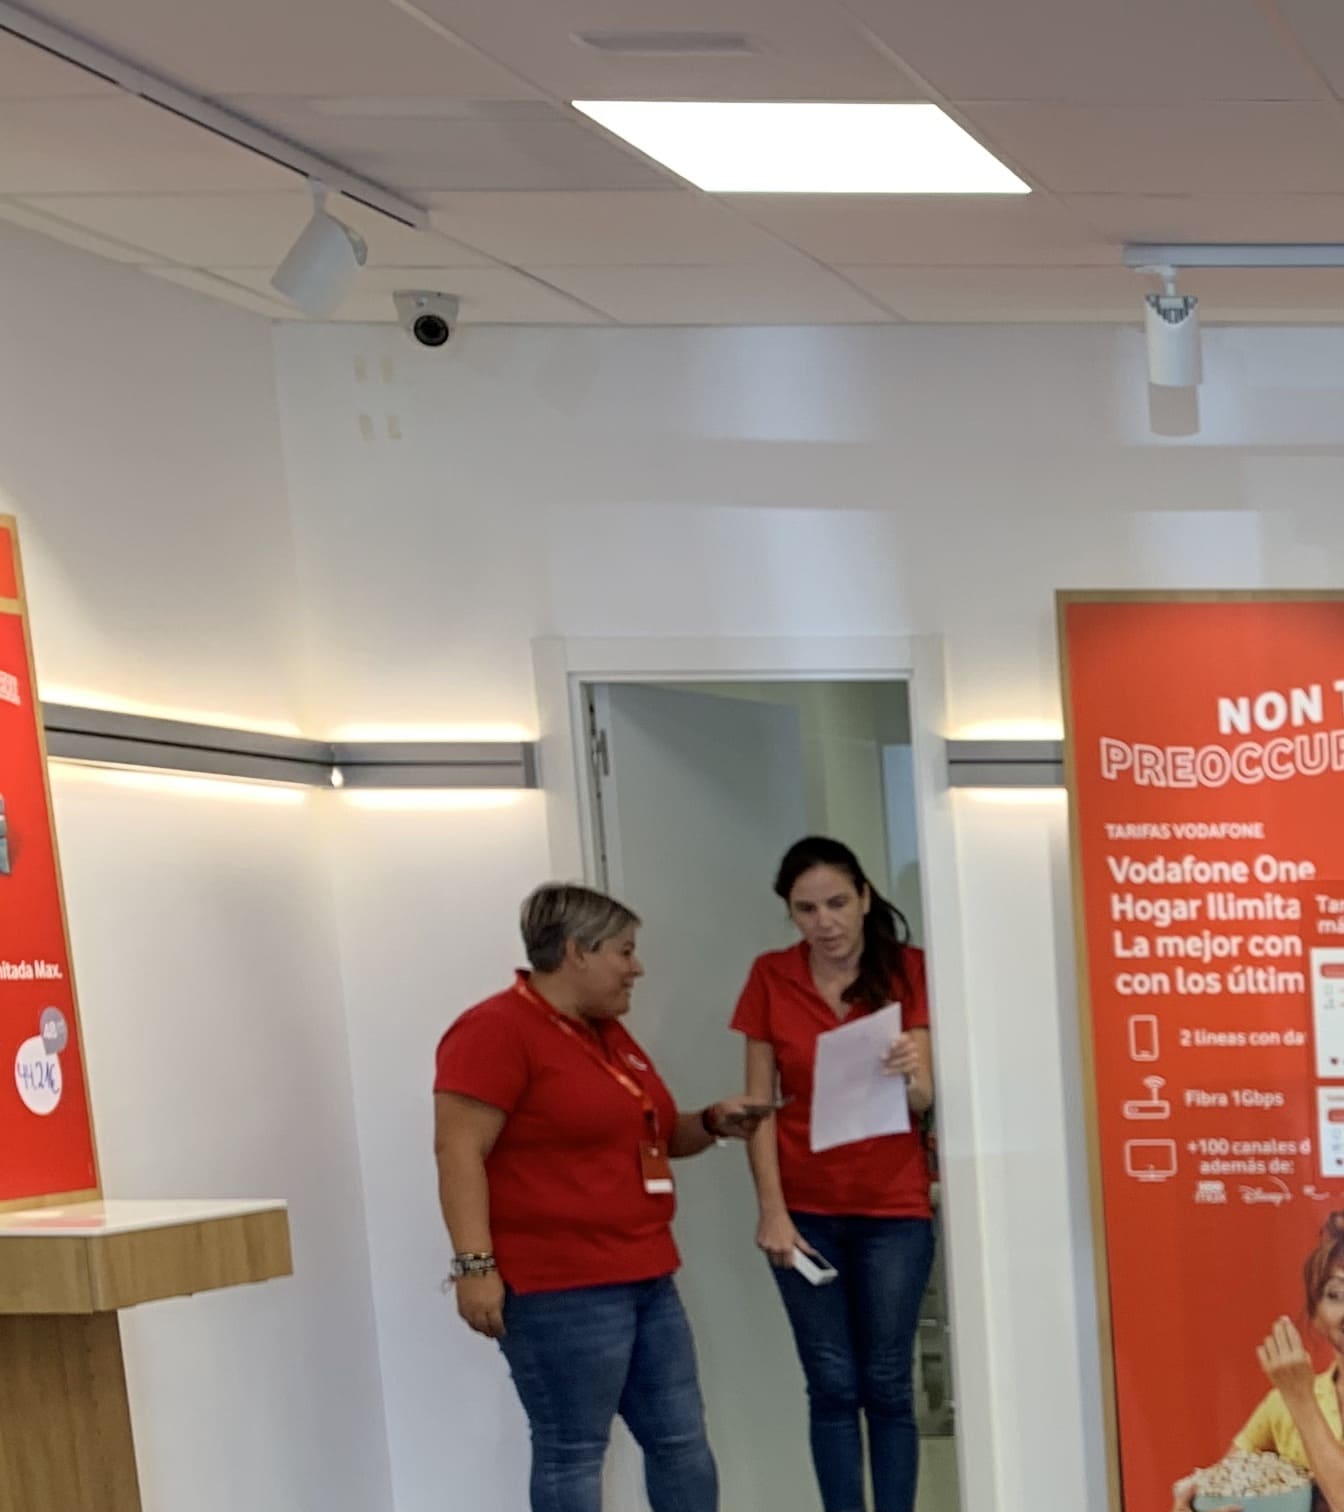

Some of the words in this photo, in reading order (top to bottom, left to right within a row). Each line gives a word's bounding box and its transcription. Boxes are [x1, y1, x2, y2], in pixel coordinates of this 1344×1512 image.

[1218, 684, 1323, 734] NON
[1104, 823, 1170, 840] TARIFAS
[1173, 822, 1264, 839] VODAFONE
[1107, 855, 1249, 884] Vodafone
[1254, 854, 1315, 883] One
[1110, 893, 1201, 927] Hogar
[1206, 892, 1301, 920] Ilimita
[1113, 930, 1149, 958] La
[1156, 930, 1243, 963] mejor
[1248, 935, 1302, 957] con
[0, 959, 33, 980] itada
[34, 959, 63, 979] Max.
[1115, 972, 1170, 995] con
[1176, 966, 1221, 994] los
[1227, 963, 1304, 993] últim
[1179, 1028, 1190, 1046] 2
[1249, 1030, 1280, 1046] con
[1183, 1089, 1228, 1106] Fibra
[1231, 1089, 1284, 1109] 1Gbps
[1186, 1137, 1229, 1155] +100
[1231, 1138, 1296, 1155] canales
[1200, 1157, 1266, 1174] además
